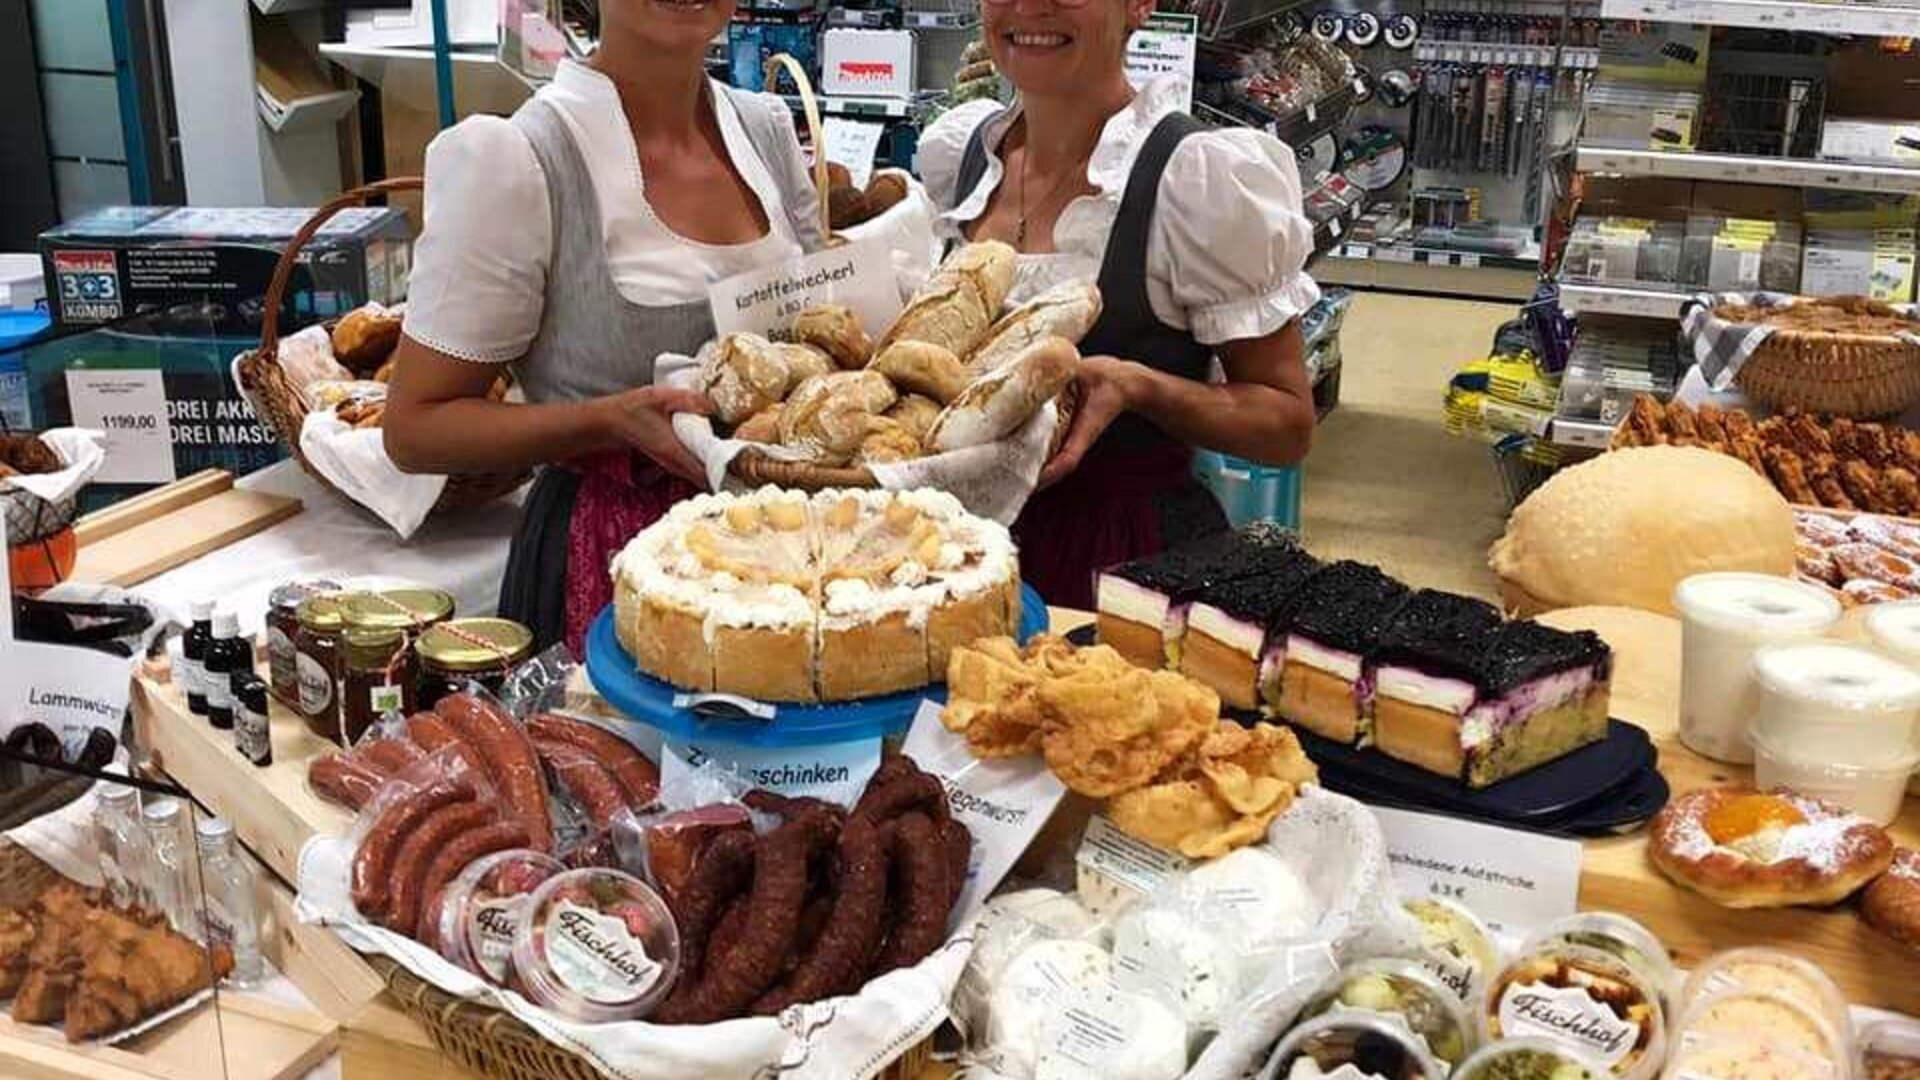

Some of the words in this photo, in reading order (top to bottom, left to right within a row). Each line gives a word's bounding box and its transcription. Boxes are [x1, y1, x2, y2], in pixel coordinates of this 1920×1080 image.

[65, 303, 118, 320] KOMBO
[168, 425, 212, 443] DREI
[218, 425, 276, 443] MASC
[559, 911, 654, 985] Fischhof
[1512, 994, 1630, 1052] Fischhof
